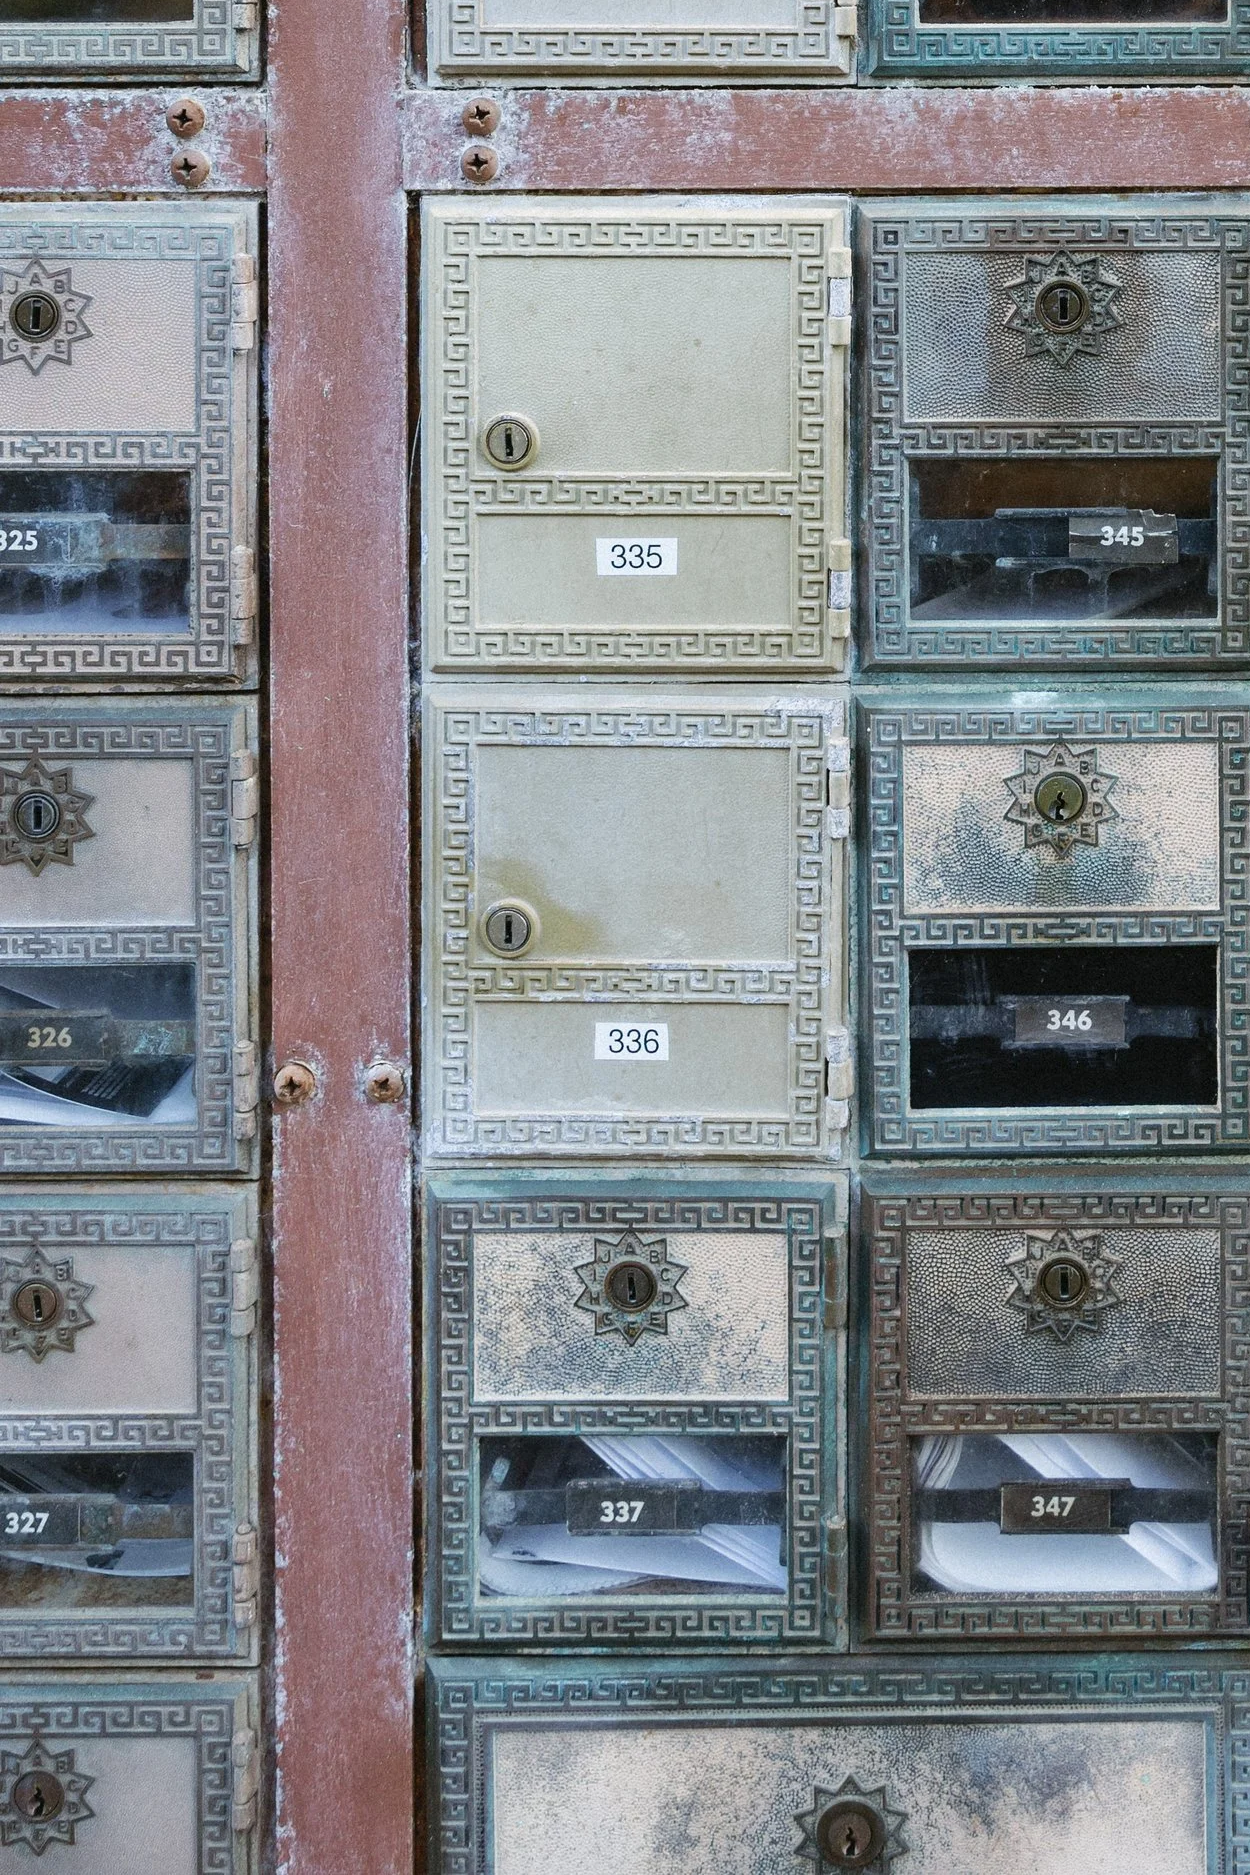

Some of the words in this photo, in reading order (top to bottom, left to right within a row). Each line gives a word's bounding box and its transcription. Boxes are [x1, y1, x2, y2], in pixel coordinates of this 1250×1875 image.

[1101, 526, 1144, 546] 345
[611, 545, 662, 568] 335
[1047, 1010, 1092, 1030] 346
[28, 1027, 72, 1047] 326
[609, 1029, 659, 1053] 336
[600, 1501, 644, 1522] 337
[1031, 1496, 1075, 1516] 347
[5, 1512, 49, 1533] 327
